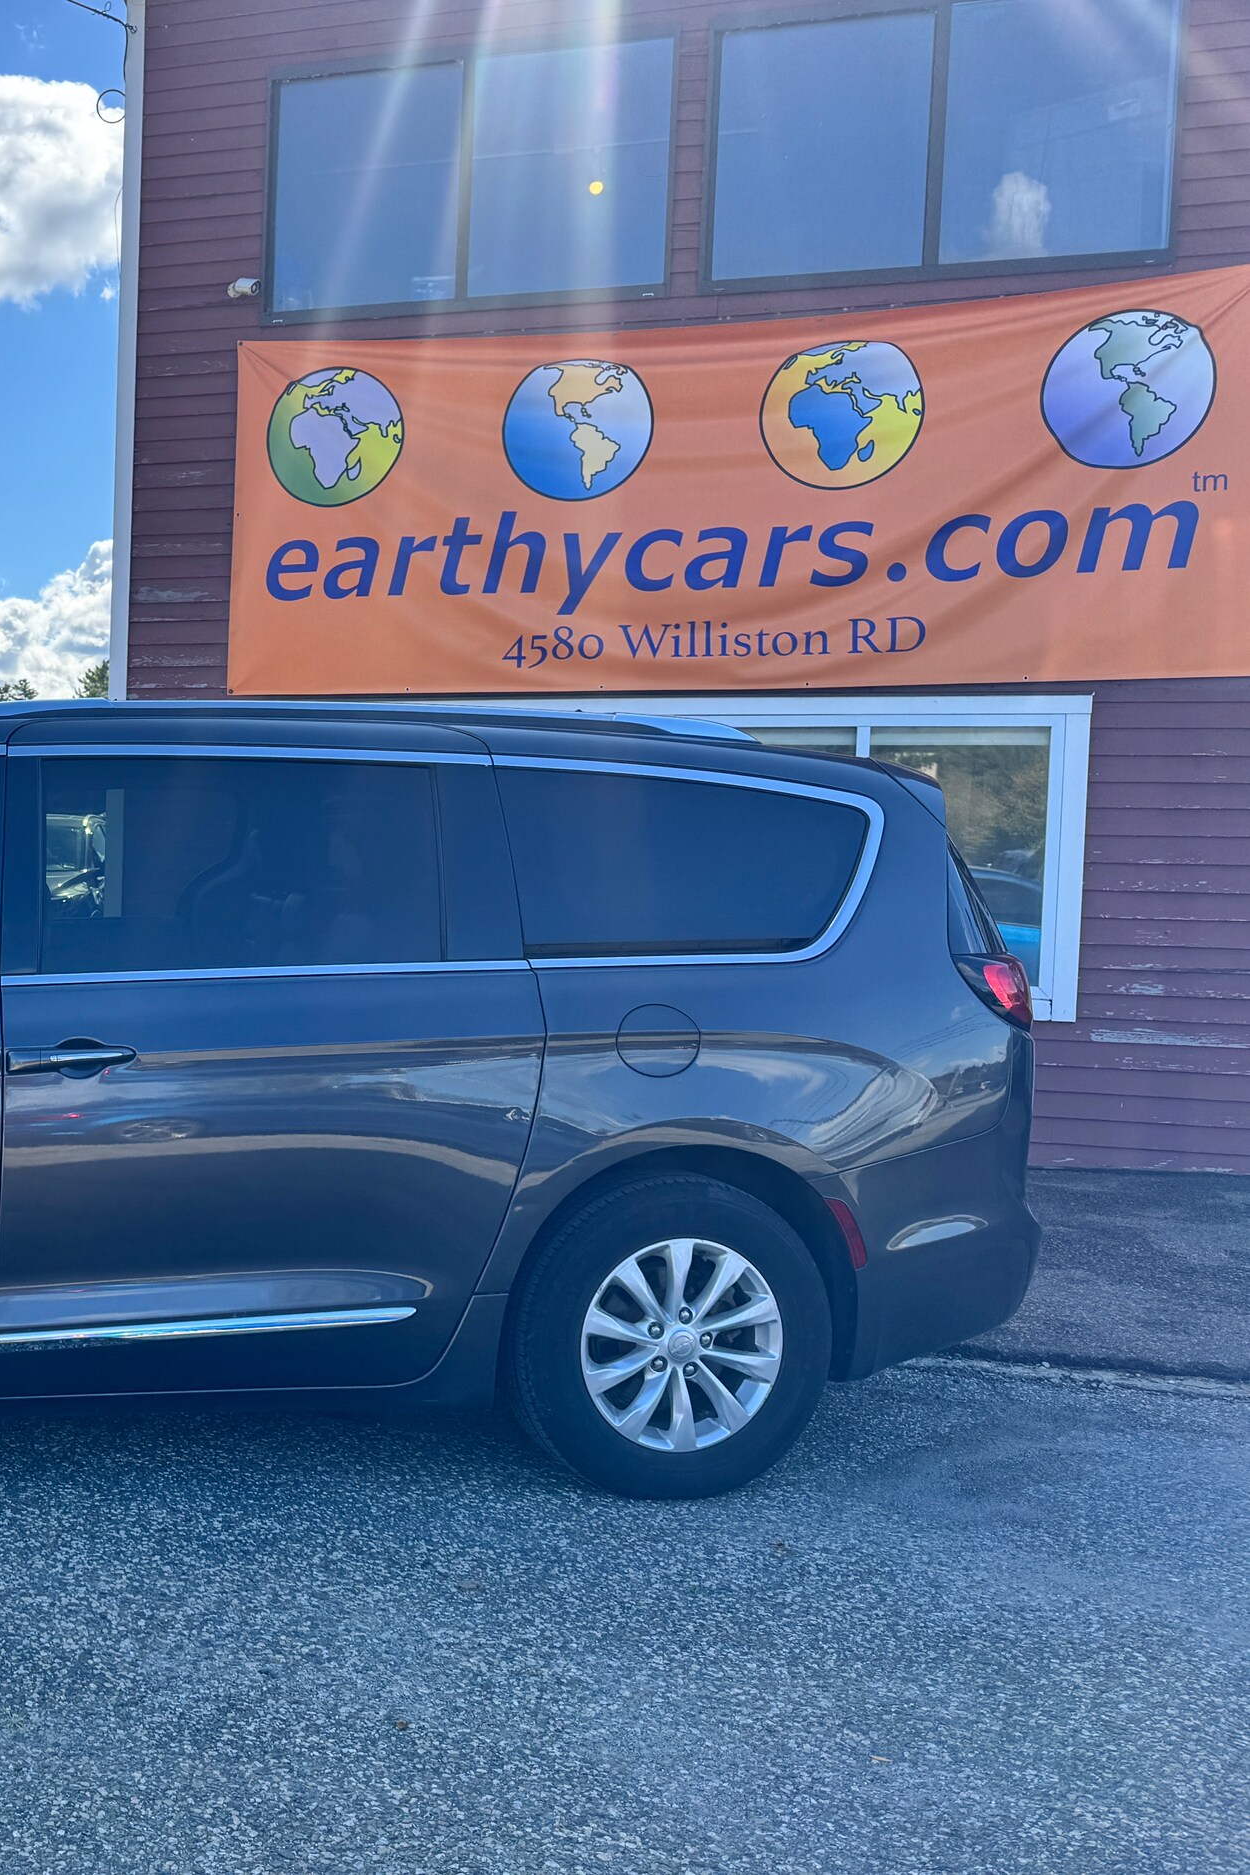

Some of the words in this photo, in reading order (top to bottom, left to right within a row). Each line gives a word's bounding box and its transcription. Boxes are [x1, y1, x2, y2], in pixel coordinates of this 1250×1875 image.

[1191, 470, 1229, 493] tm
[264, 499, 1200, 616] earthycars.com
[501, 625, 605, 669] 4580
[618, 617, 831, 660] Williston
[847, 616, 927, 655] RD
